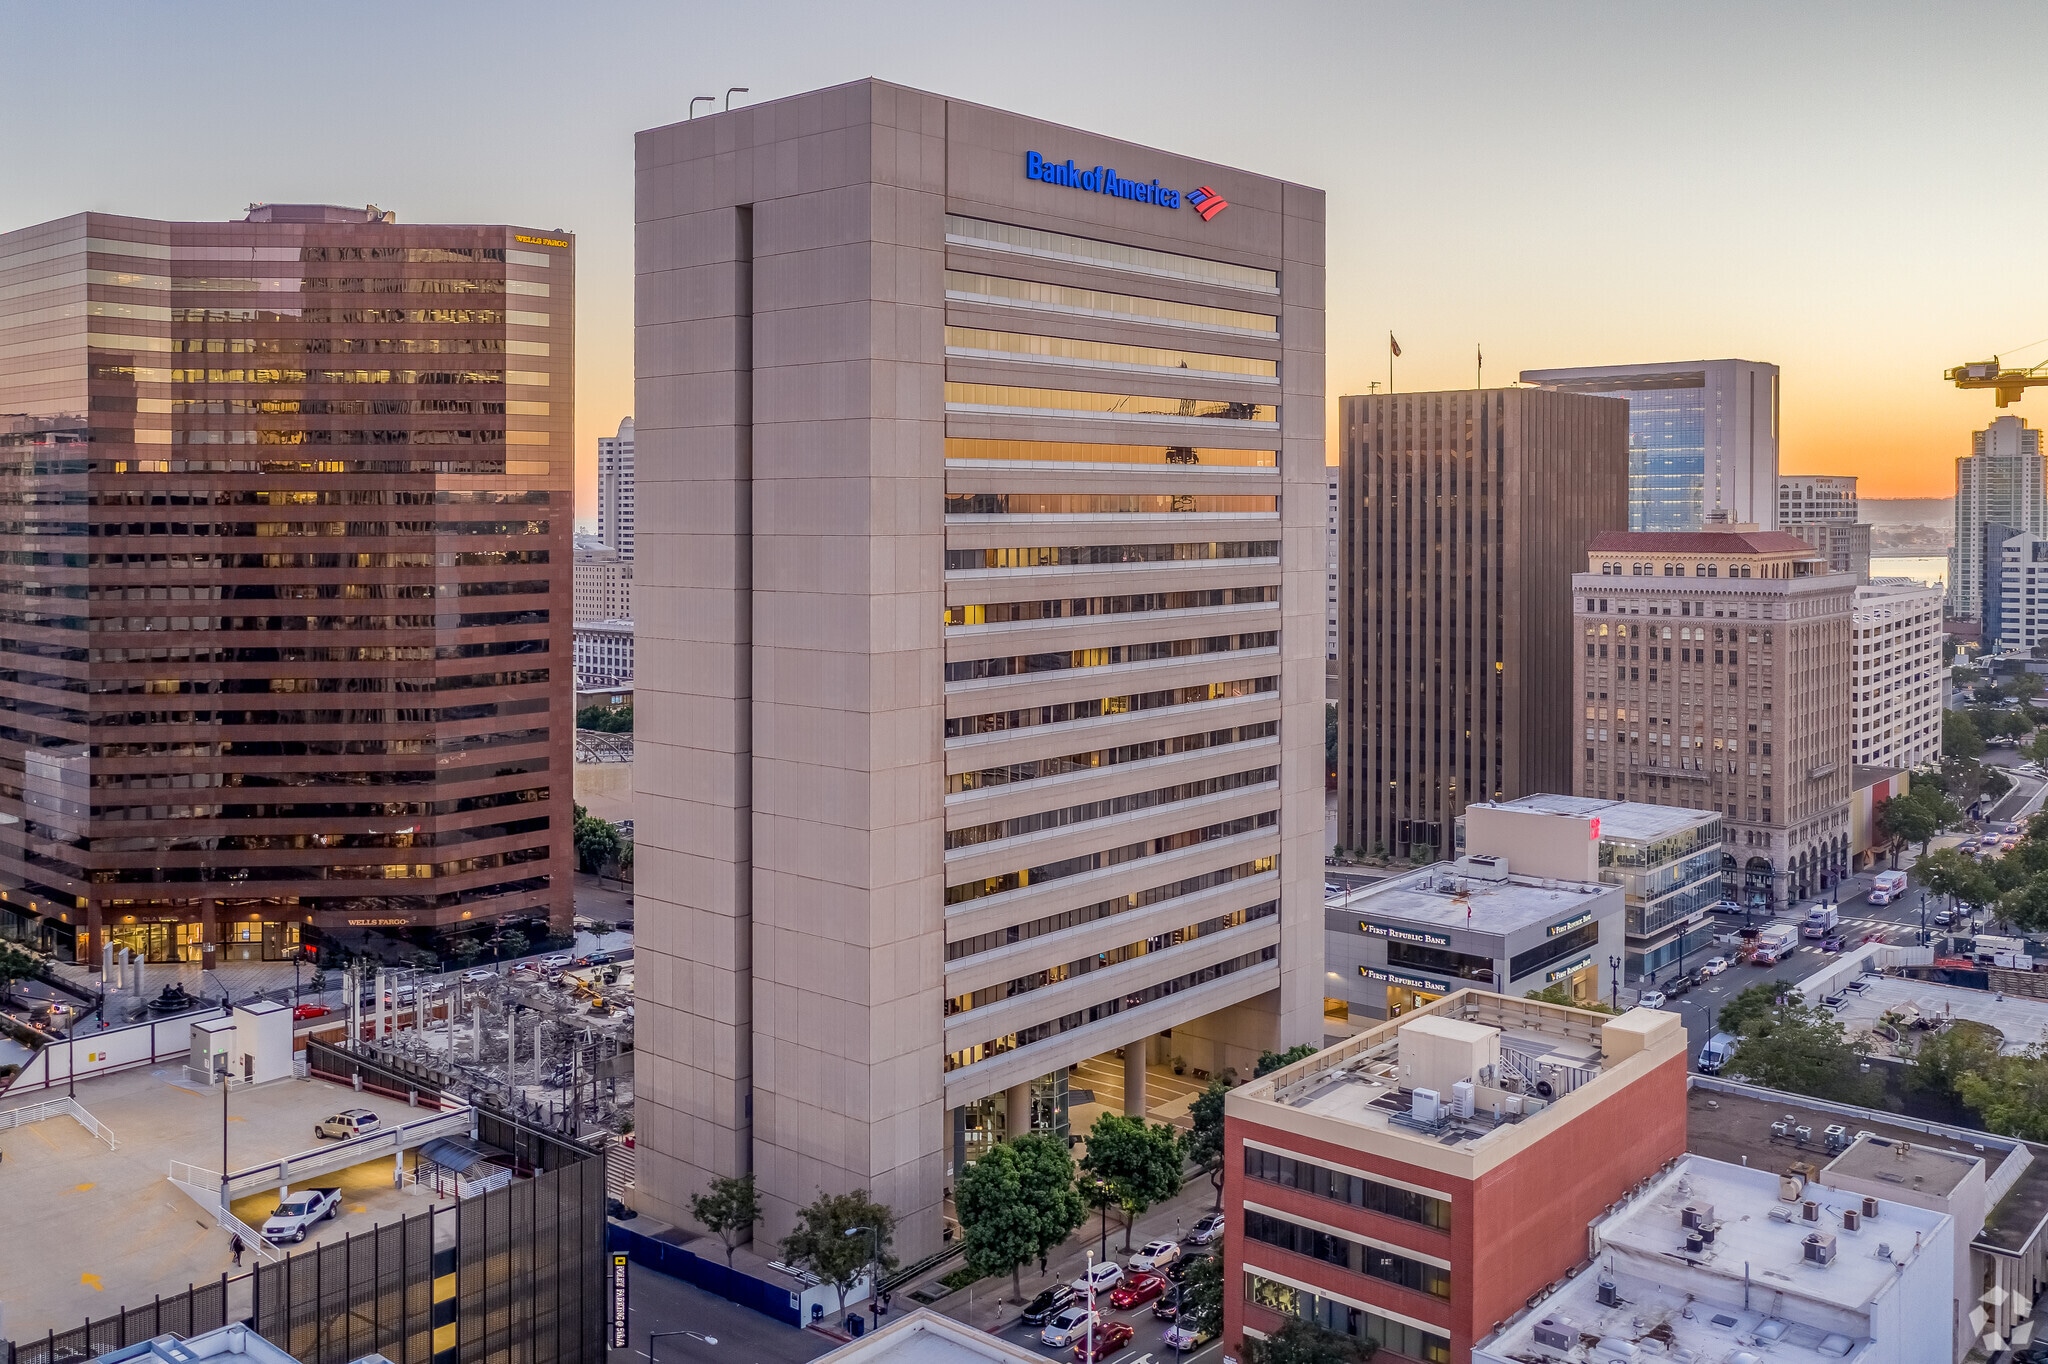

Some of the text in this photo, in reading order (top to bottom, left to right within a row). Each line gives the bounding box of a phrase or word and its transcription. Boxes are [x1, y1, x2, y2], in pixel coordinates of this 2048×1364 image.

[1026, 150, 1181, 209] Bank of America
[514, 234, 569, 248] WELLS FARGO
[378, 918, 406, 926] FARGO
[1368, 924, 1446, 945] FIRST REPUBLIC BANK
[1368, 969, 1446, 992] FIRST REPUBLIC BANK
